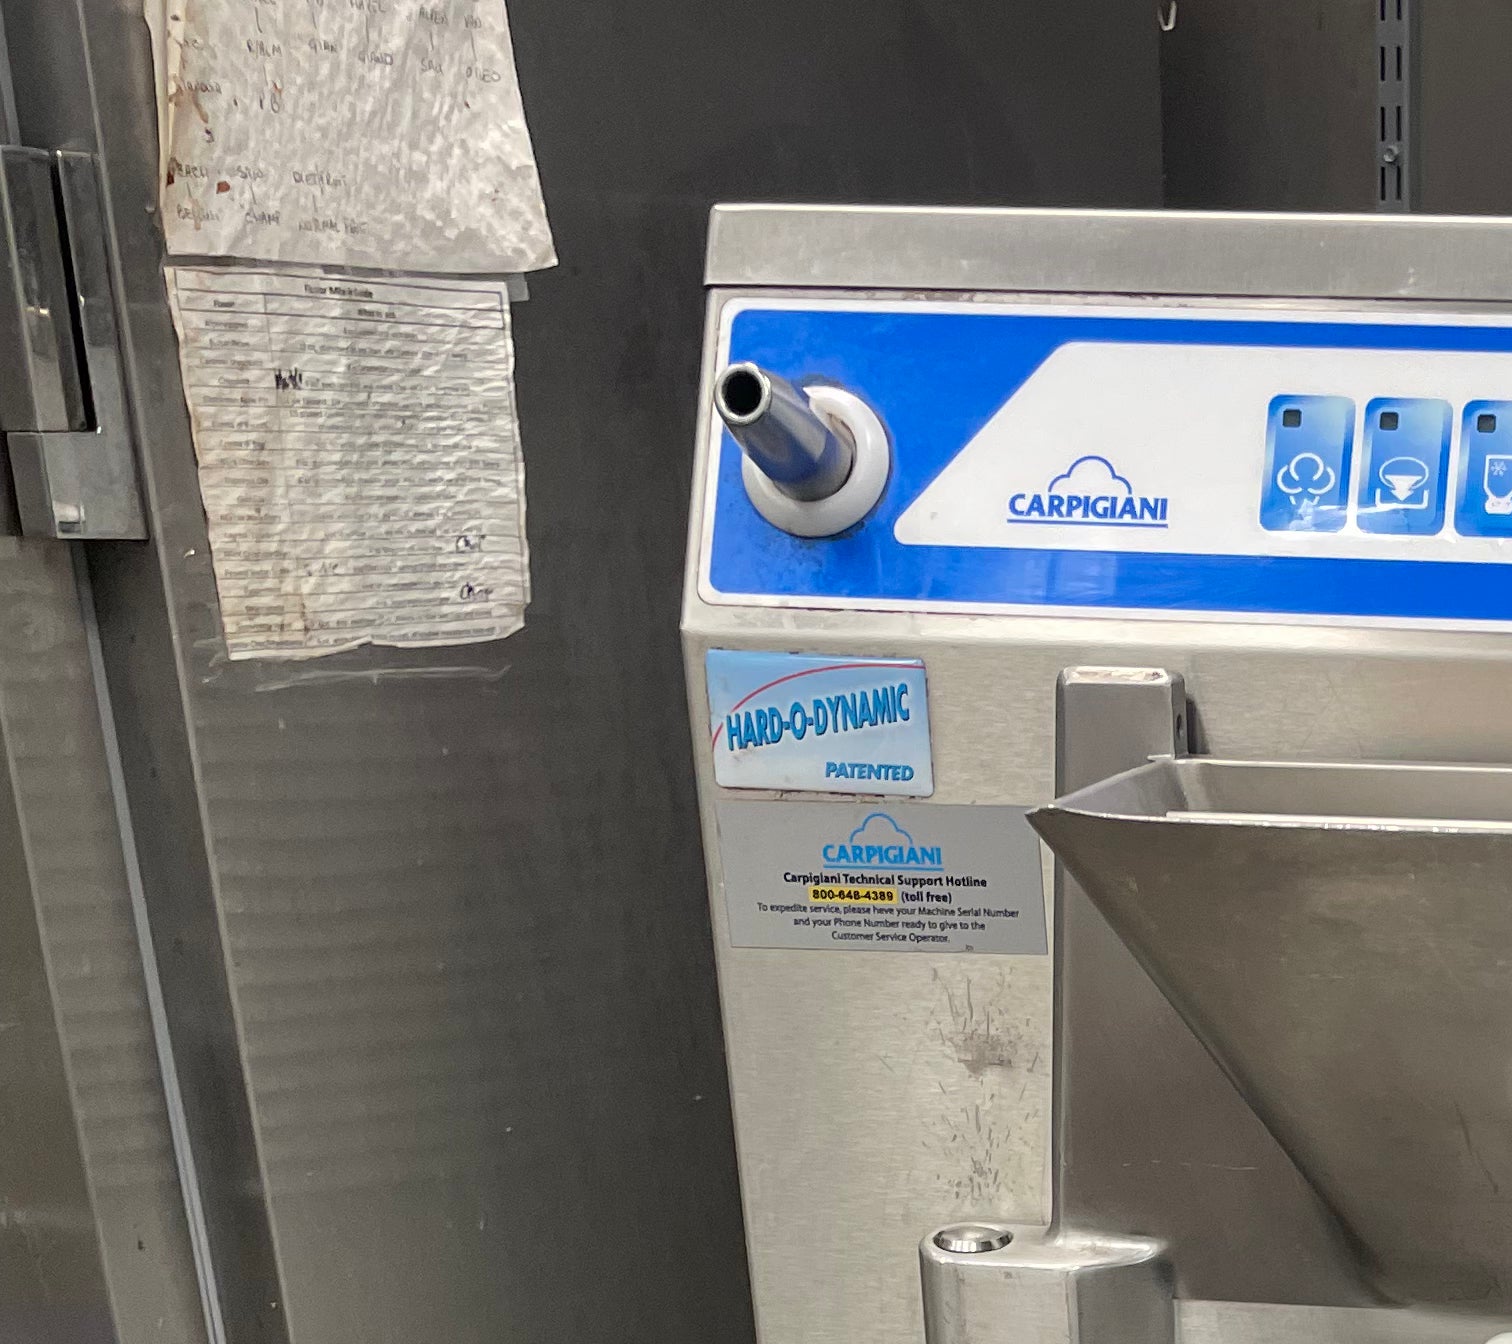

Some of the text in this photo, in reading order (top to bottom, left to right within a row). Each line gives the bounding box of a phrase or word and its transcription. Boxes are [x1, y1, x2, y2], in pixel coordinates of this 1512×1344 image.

[1008, 493, 1168, 521] CARPIGIANI
[726, 683, 910, 751] HARD-O-DYNAMIC
[825, 761, 914, 782] PATENTED
[822, 843, 943, 865] CARPIGIANI
[783, 872, 987, 889] Carpigiani Technical Support Hotline
[901, 891, 924, 903] (toll
[925, 892, 952, 904] free)
[757, 903, 768, 912] To
[769, 903, 808, 915] expedite
[843, 905, 871, 917] please
[872, 906, 895, 915] have
[896, 908, 916, 918] your
[918, 907, 955, 916] Machine
[957, 907, 981, 917] Serial
[983, 908, 1019, 918] Number
[793, 917, 985, 931] and your Phone Number ready to give to the
[831, 931, 875, 941] Customer
[876, 932, 907, 942] Service
